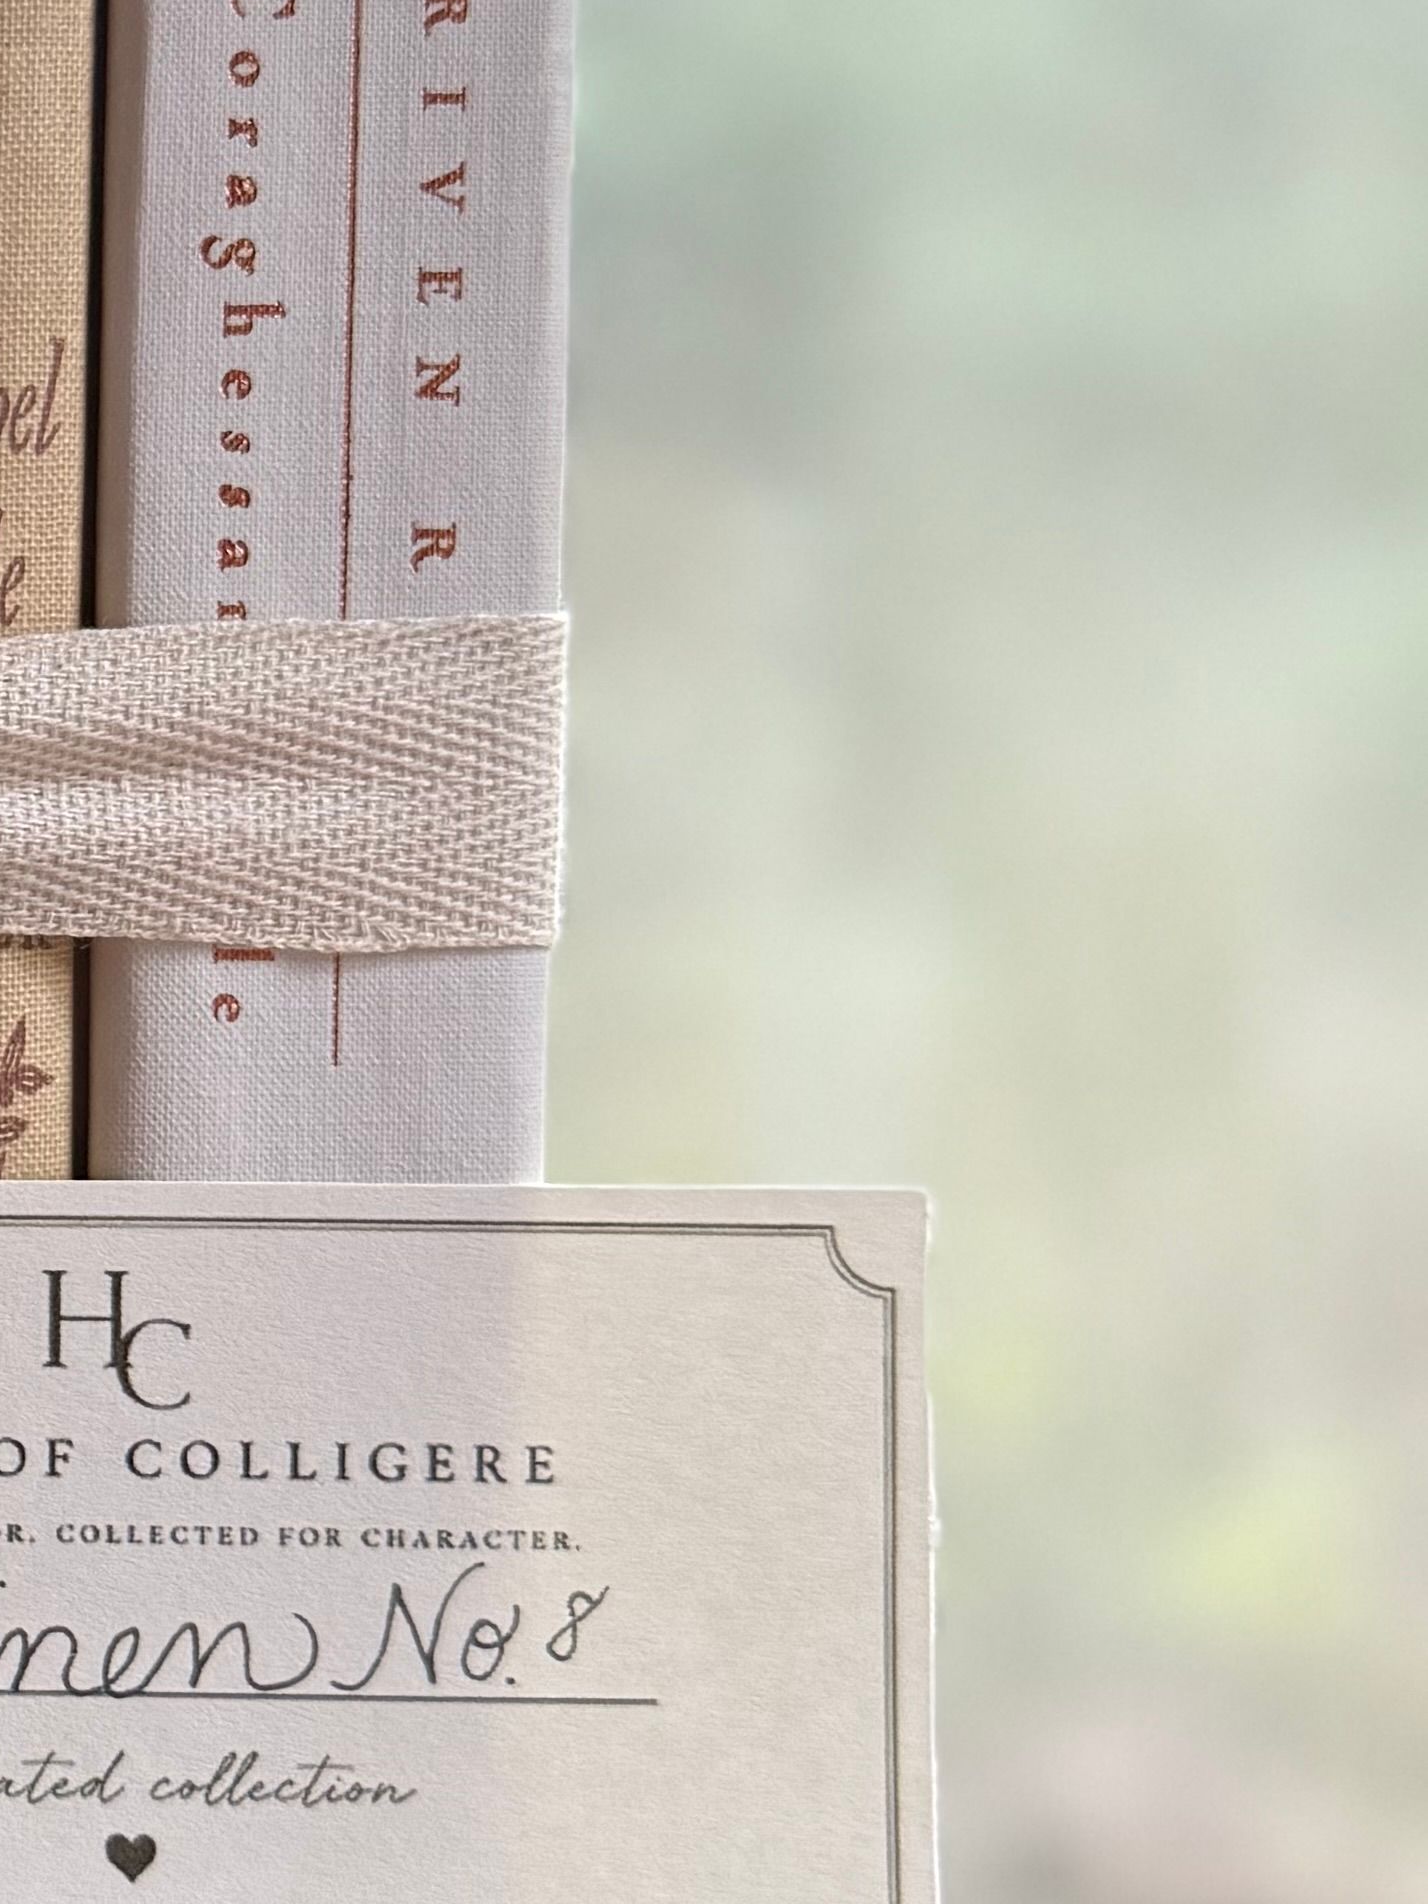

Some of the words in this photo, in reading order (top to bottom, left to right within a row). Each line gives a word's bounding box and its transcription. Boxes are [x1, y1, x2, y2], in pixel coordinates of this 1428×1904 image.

[39, 1268, 194, 1413] HC
[123, 1437, 558, 1487] COLLIGERE
[54, 1522, 261, 1549] COLLECTED
[277, 1525, 345, 1550] FOR
[358, 1526, 583, 1553] CHARACTER.
[545, 1584, 610, 1663] 8
[147, 1748, 419, 1810] collection
